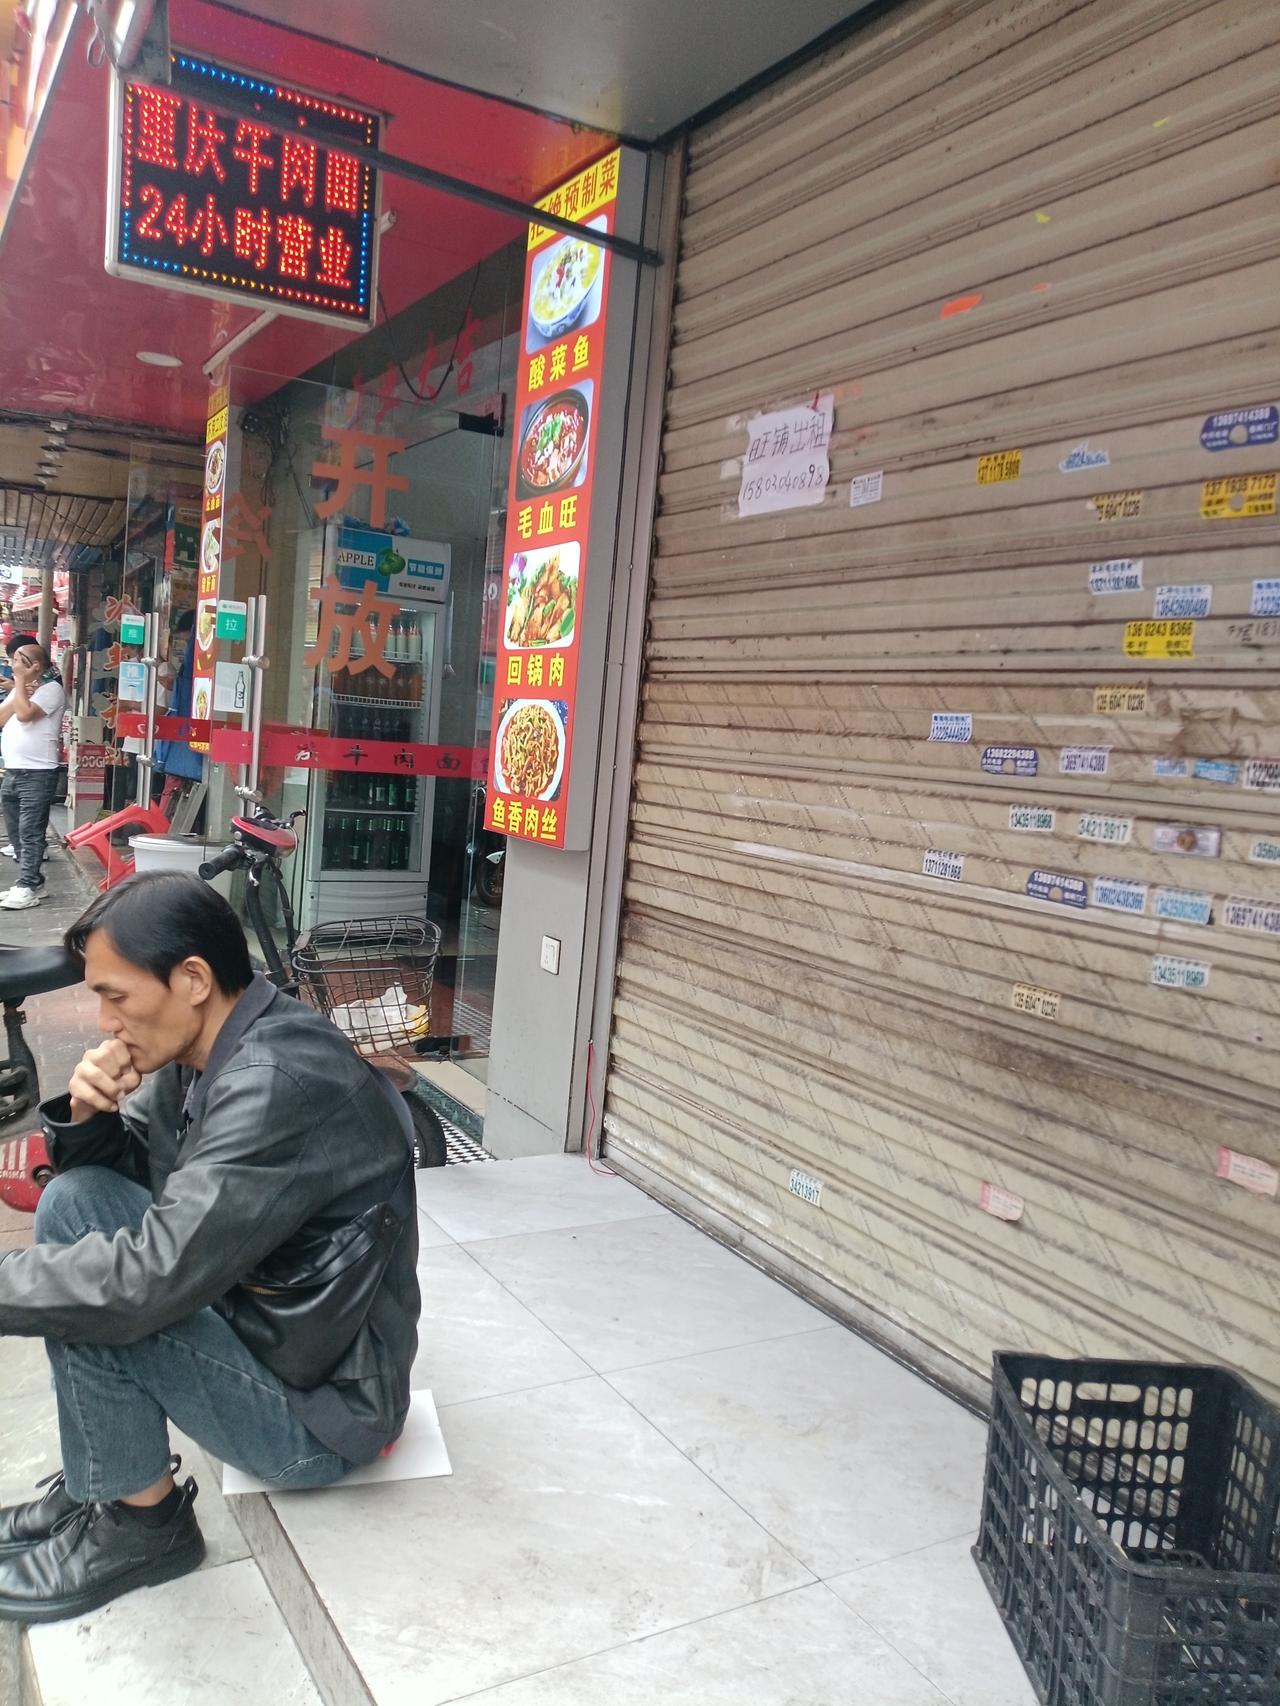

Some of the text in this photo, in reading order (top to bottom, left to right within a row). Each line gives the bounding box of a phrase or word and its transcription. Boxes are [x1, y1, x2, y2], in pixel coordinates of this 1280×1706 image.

[136, 184, 352, 289] 24小时营业
[528, 334, 590, 392] 酸菜鱼
[748, 412, 827, 462] 旺铺出租
[517, 495, 578, 540] 毛血旺
[338, 551, 374, 567] APPLE
[225, 618, 238, 631] 拉
[506, 652, 565, 688] 回锅肉
[492, 796, 558, 842] 鱼香肉丝
[1079, 817, 1129, 841] 34213917
[790, 1178, 820, 1204] 34213917
